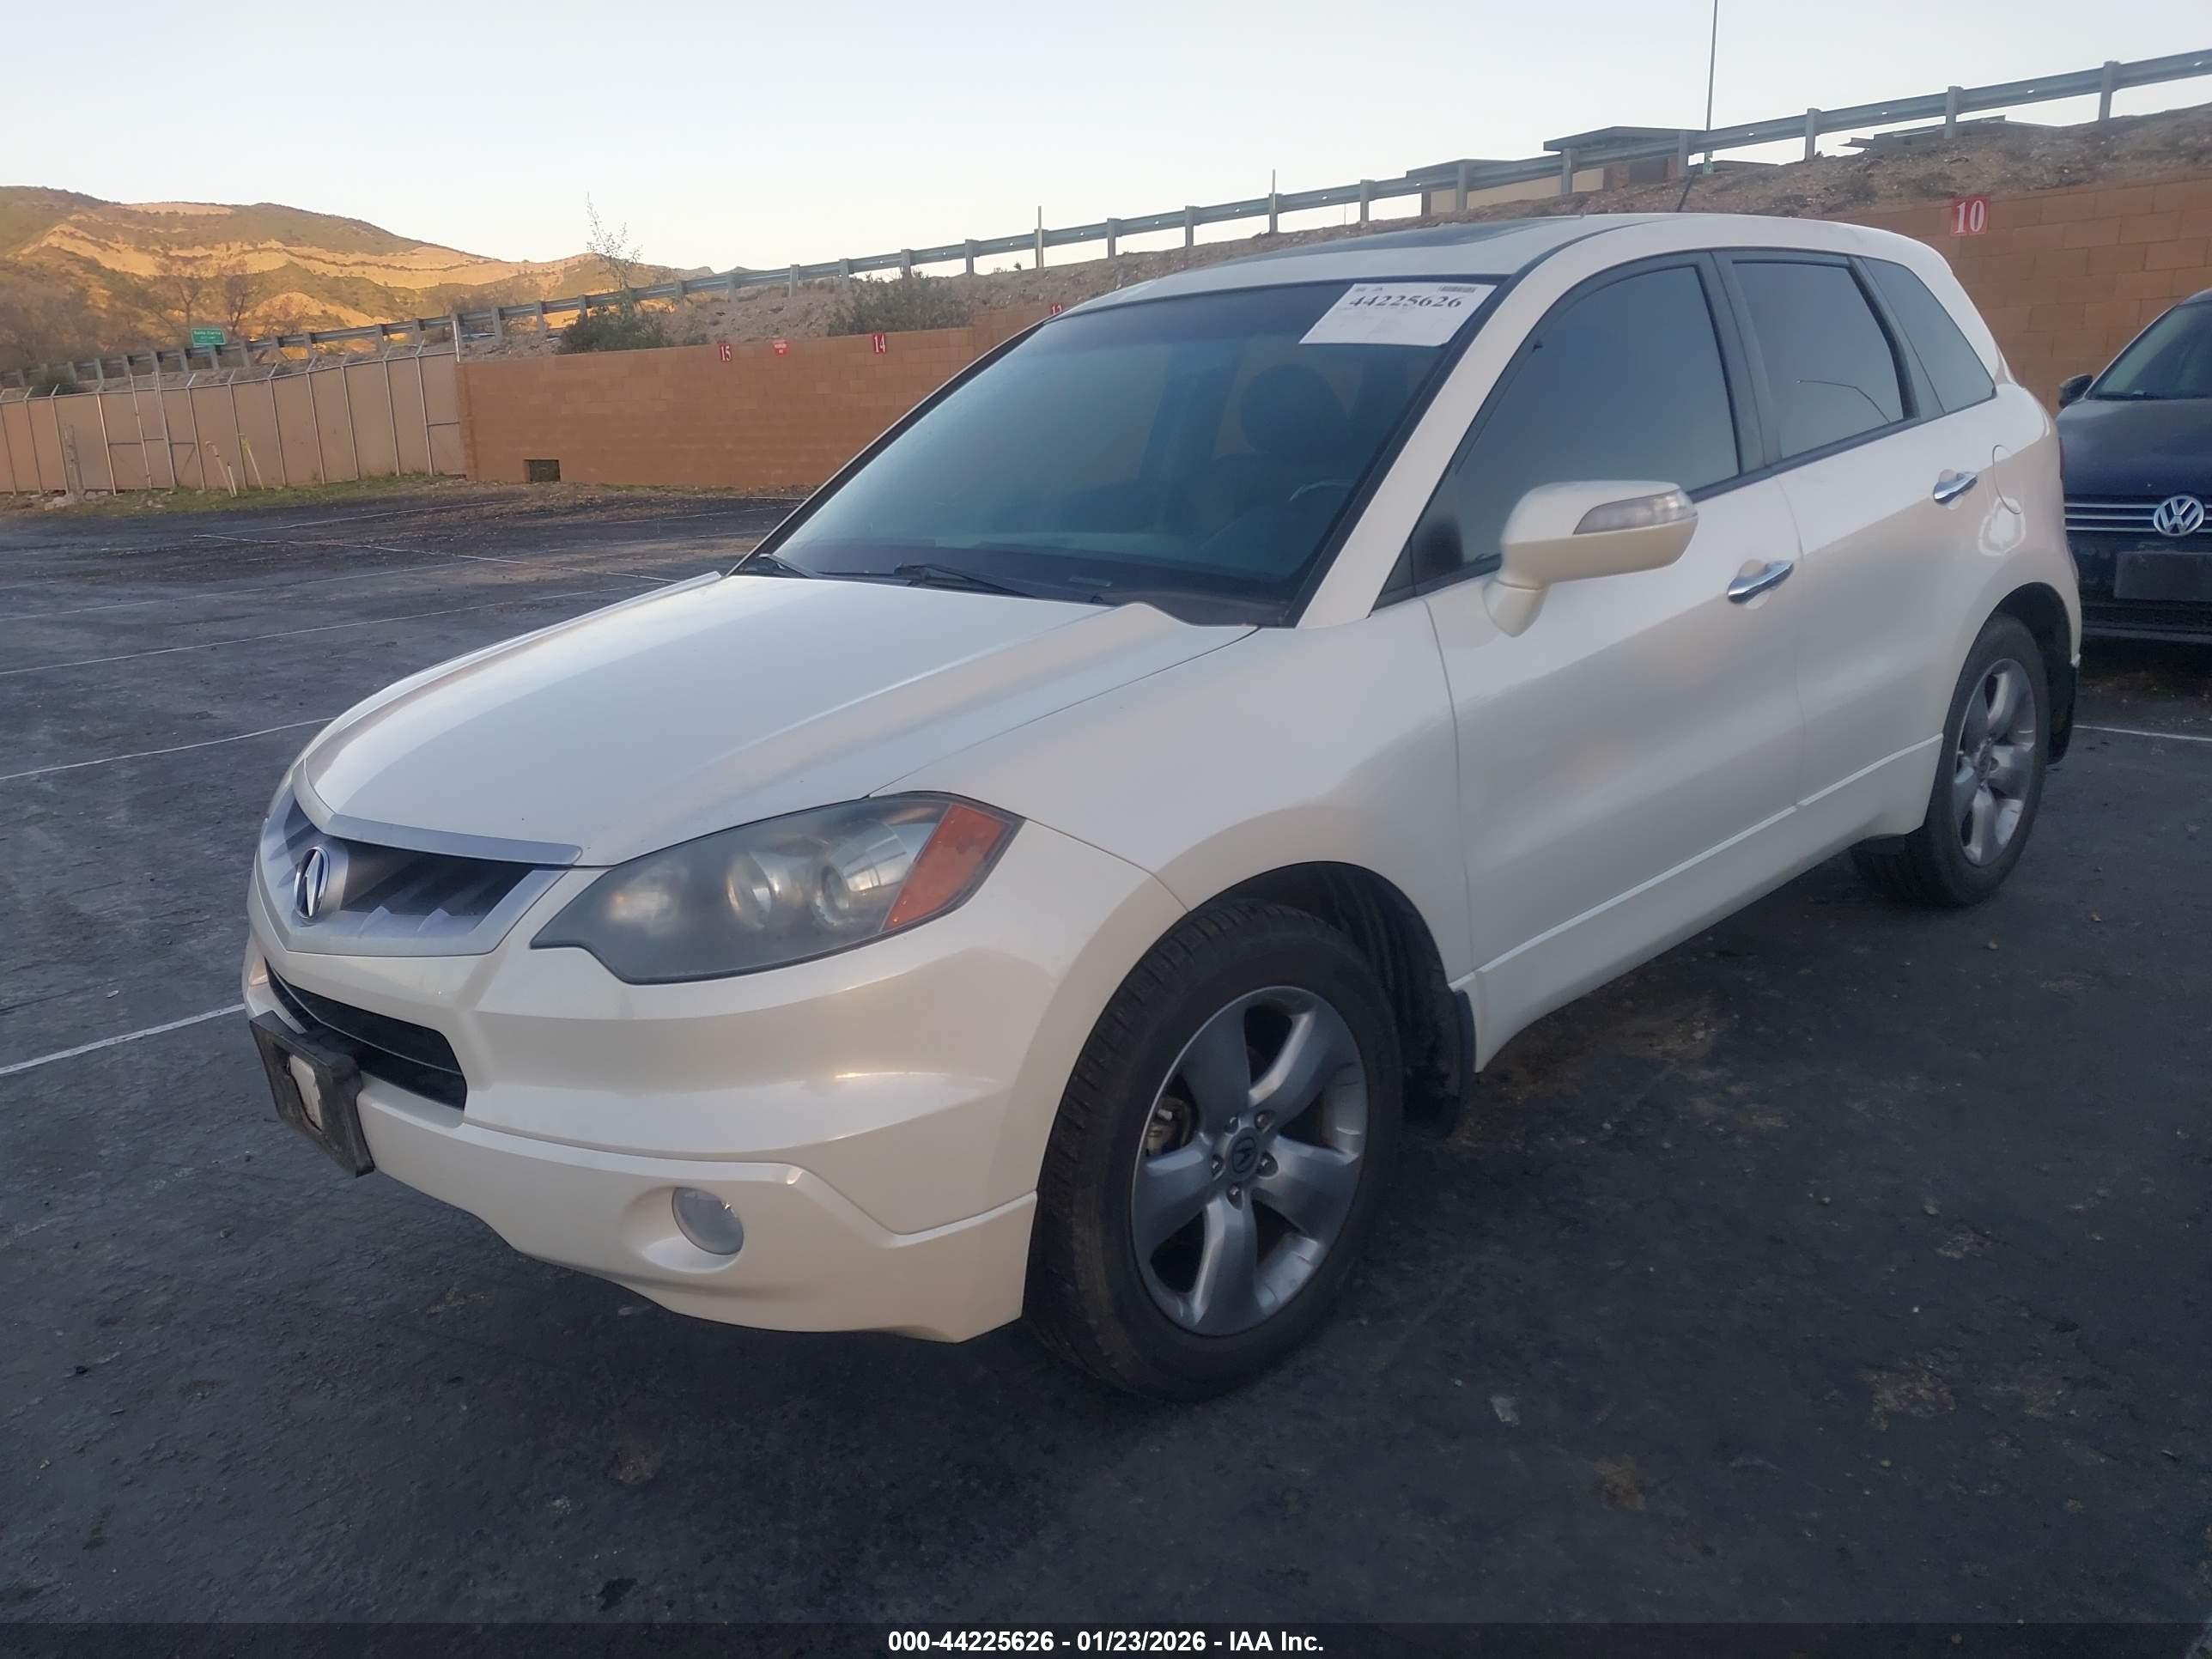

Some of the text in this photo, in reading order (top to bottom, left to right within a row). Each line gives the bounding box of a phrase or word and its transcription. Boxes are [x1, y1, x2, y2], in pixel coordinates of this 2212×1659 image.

[1955, 200, 1985, 234] 10
[1349, 295, 1465, 307] 44225626
[874, 333, 885, 353] 14
[721, 344, 732, 362] 15
